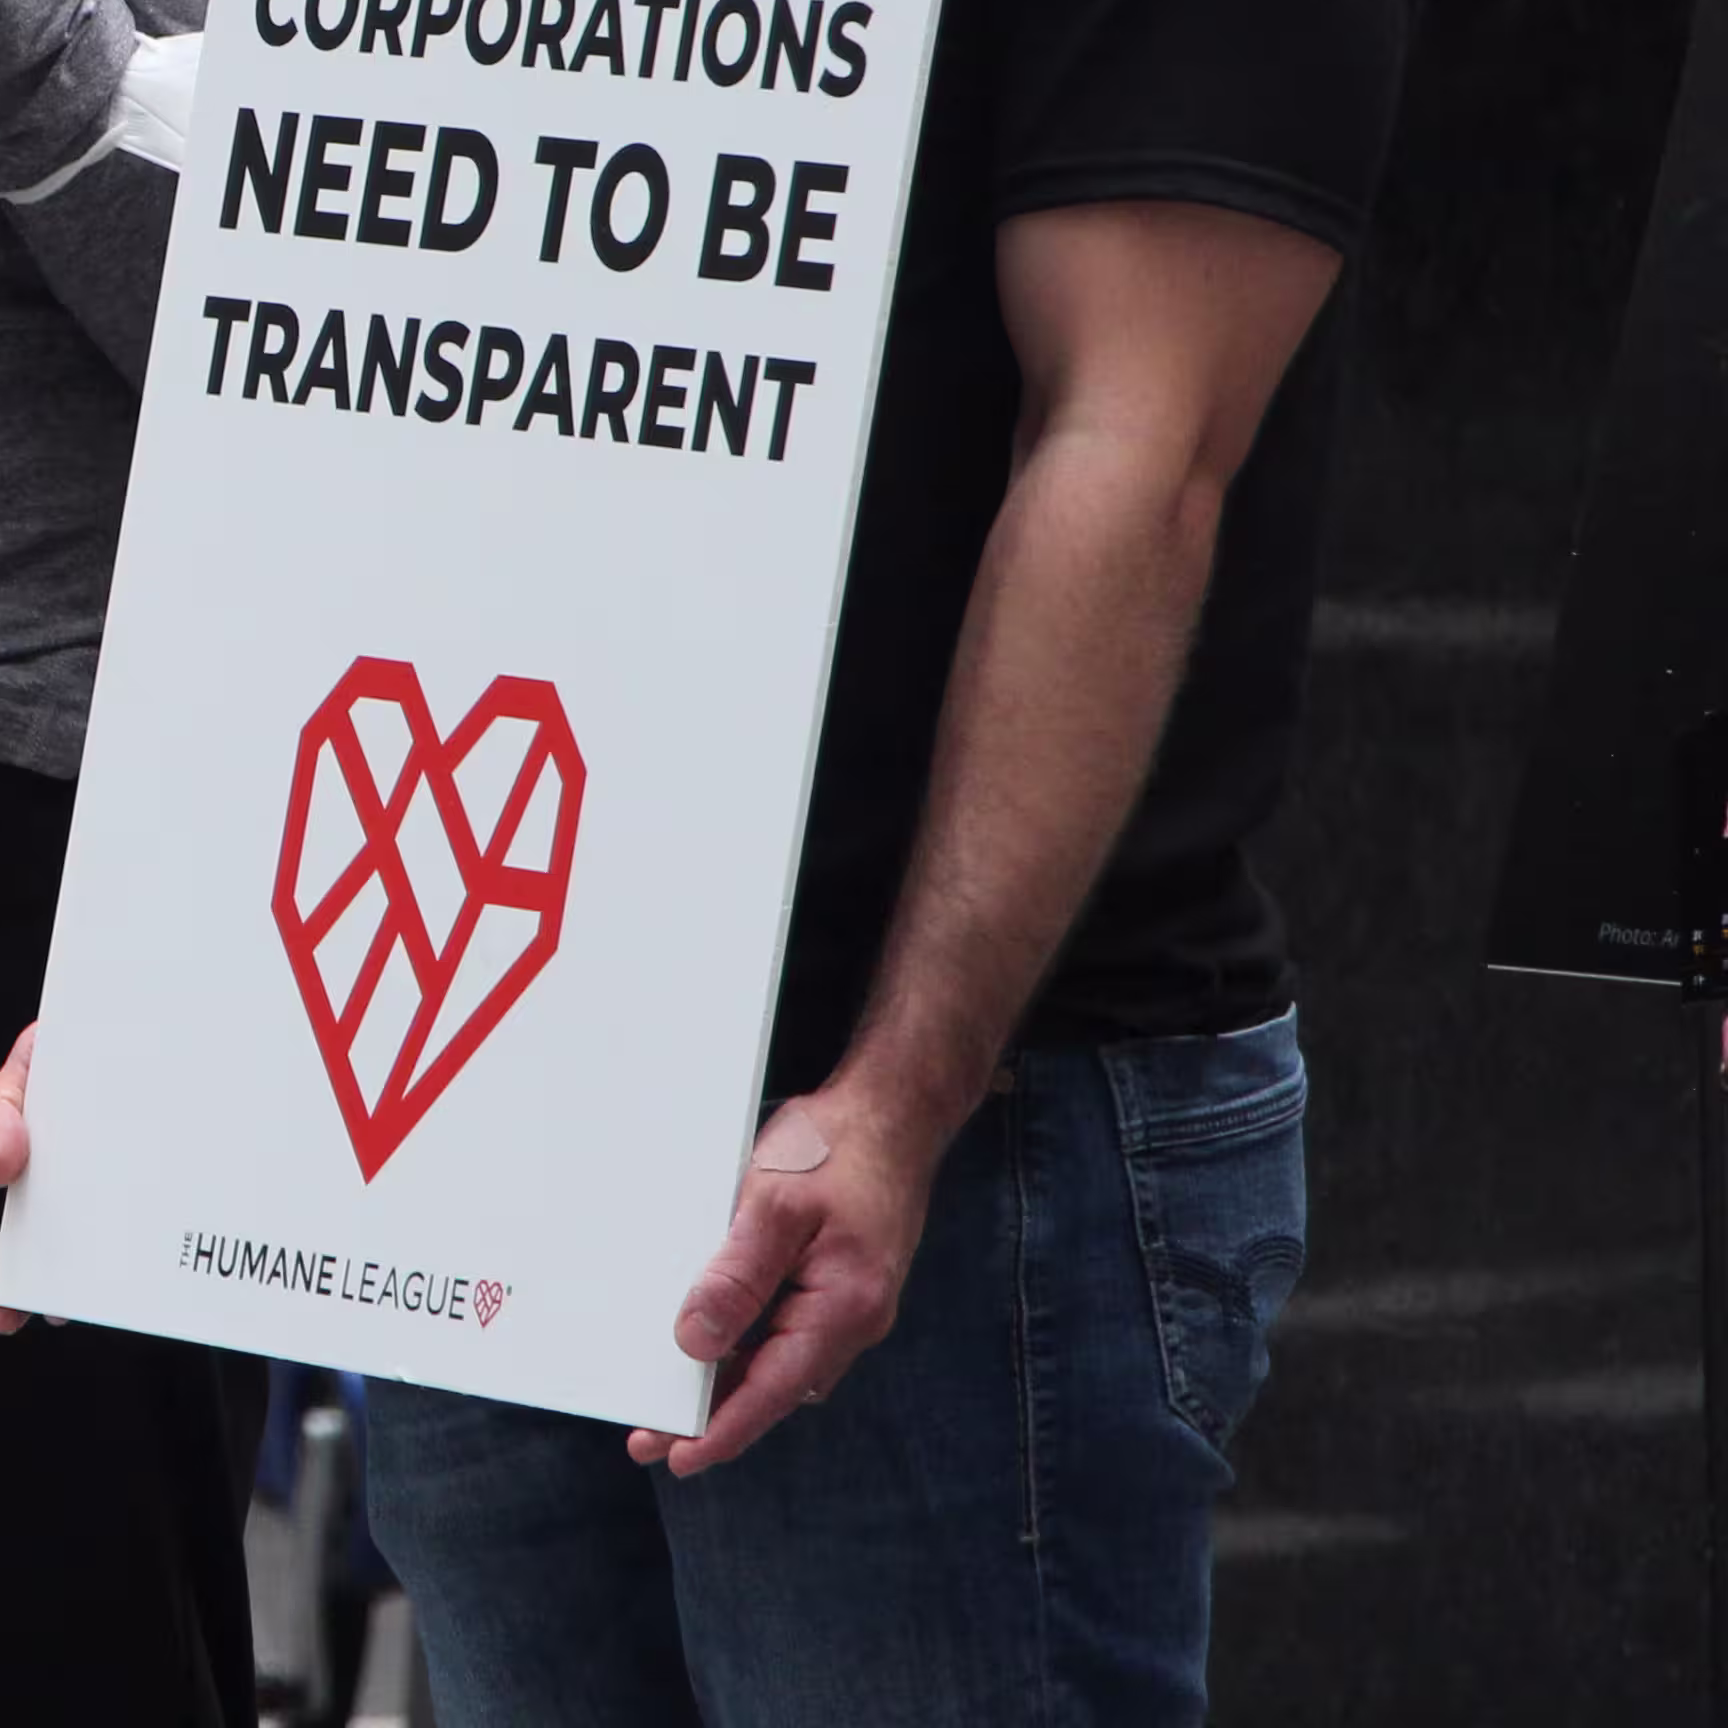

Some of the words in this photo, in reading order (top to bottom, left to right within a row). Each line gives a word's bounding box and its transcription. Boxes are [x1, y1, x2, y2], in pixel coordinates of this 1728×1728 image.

[219, 107, 499, 253] NEED
[534, 135, 670, 272] TO
[697, 153, 850, 292] BE
[203, 295, 817, 462] TRANSPARENT
[1598, 922, 1656, 946] Photo:
[193, 1232, 337, 1296] HUMANE
[341, 1258, 470, 1321] LEAGUE
